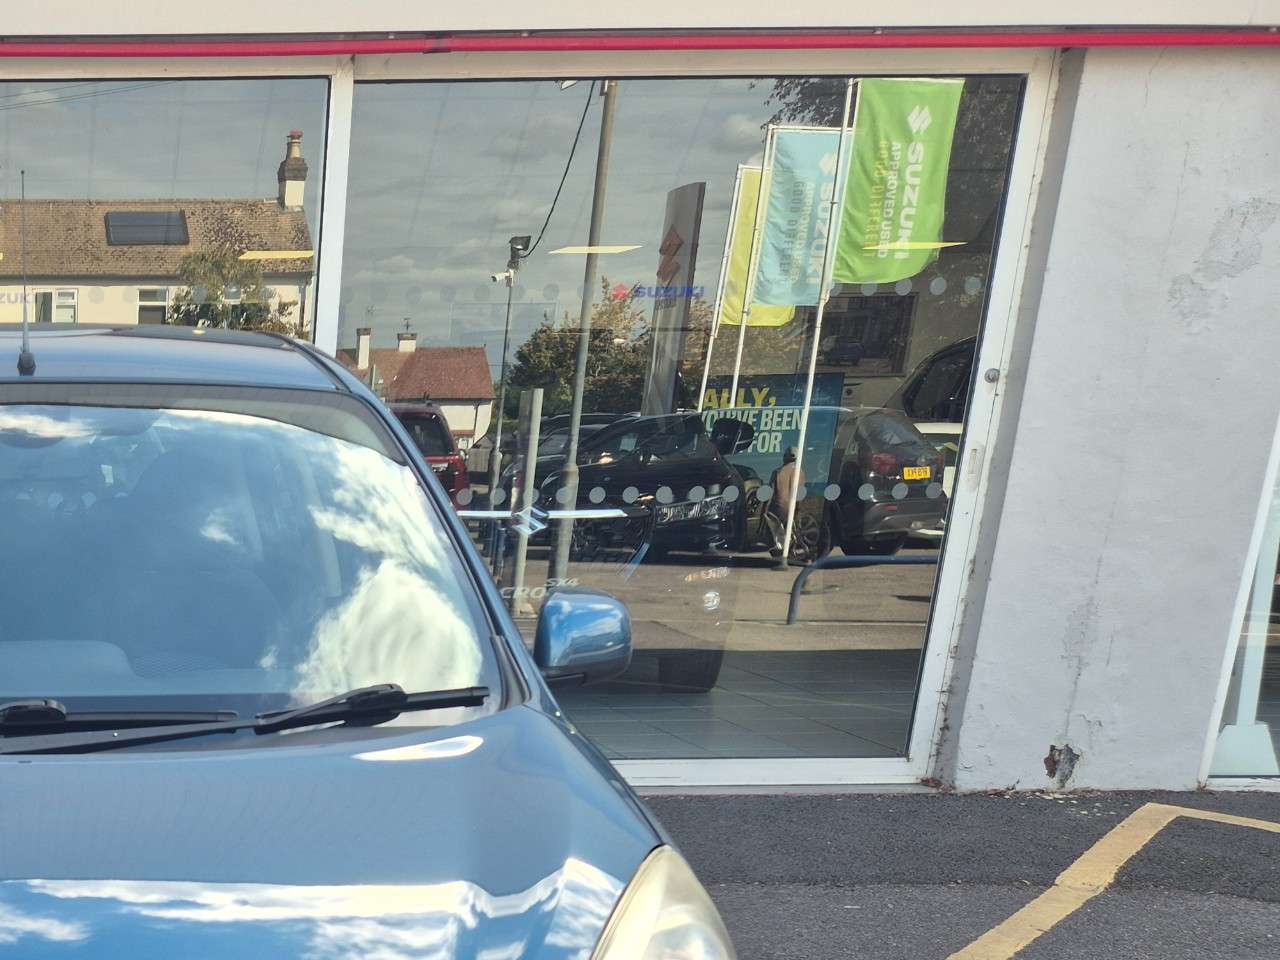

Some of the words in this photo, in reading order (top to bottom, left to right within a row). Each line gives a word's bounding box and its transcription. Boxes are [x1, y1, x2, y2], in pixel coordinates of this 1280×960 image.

[883, 141, 902, 219] APPROVED
[894, 142, 924, 259] SUZUKI
[634, 286, 705, 297] SUZUKI
[760, 408, 804, 431] BEEN
[544, 577, 579, 587] SX4
[500, 586, 547, 599] CRO
